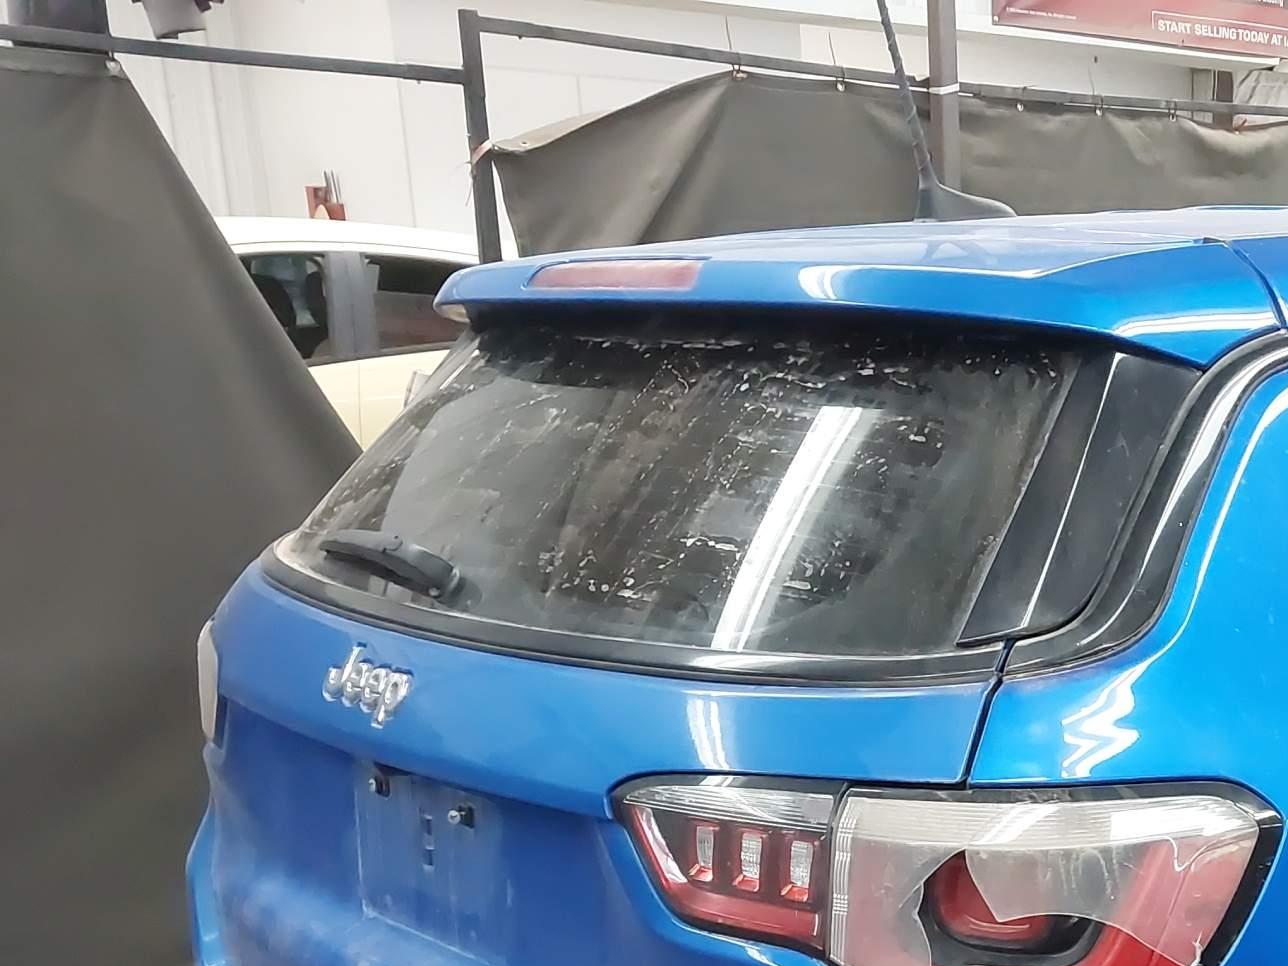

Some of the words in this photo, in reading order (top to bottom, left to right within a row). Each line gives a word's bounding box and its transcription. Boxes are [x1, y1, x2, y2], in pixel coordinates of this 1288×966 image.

[1157, 19, 1191, 34] START
[1194, 23, 1237, 41] SELLING
[1237, 28, 1270, 43] TODAY
[1270, 34, 1283, 47] AT
[322, 642, 413, 729] Jeep
